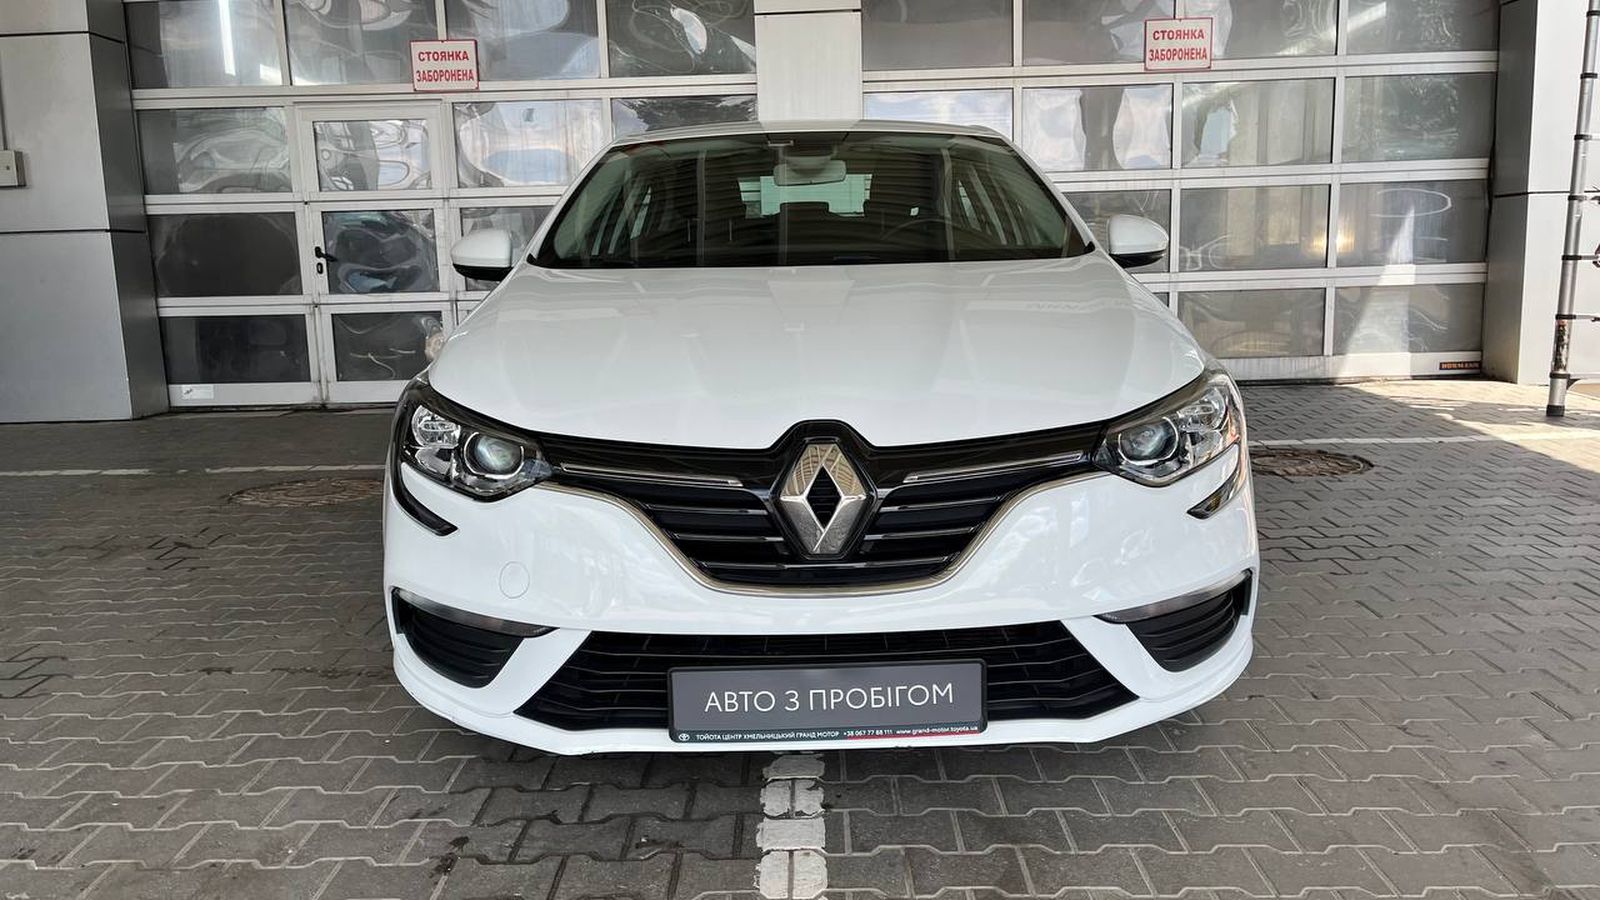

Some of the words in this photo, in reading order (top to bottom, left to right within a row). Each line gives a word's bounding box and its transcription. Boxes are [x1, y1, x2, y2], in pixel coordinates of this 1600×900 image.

[1153, 29, 1205, 40] СТОЯНКА
[418, 51, 469, 61] СТОЯНКА
[1149, 48, 1207, 61] ЗАБОРОНЕНА
[416, 70, 474, 82] ЗАБОРОНЕНА
[704, 691, 776, 712] АВТО
[784, 689, 800, 711] З
[809, 683, 954, 710] ПРОБІГОМ
[743, 732, 794, 740] ХМЕЛЬНИЦЬКИЙ
[795, 731, 816, 739] ГРАНД
